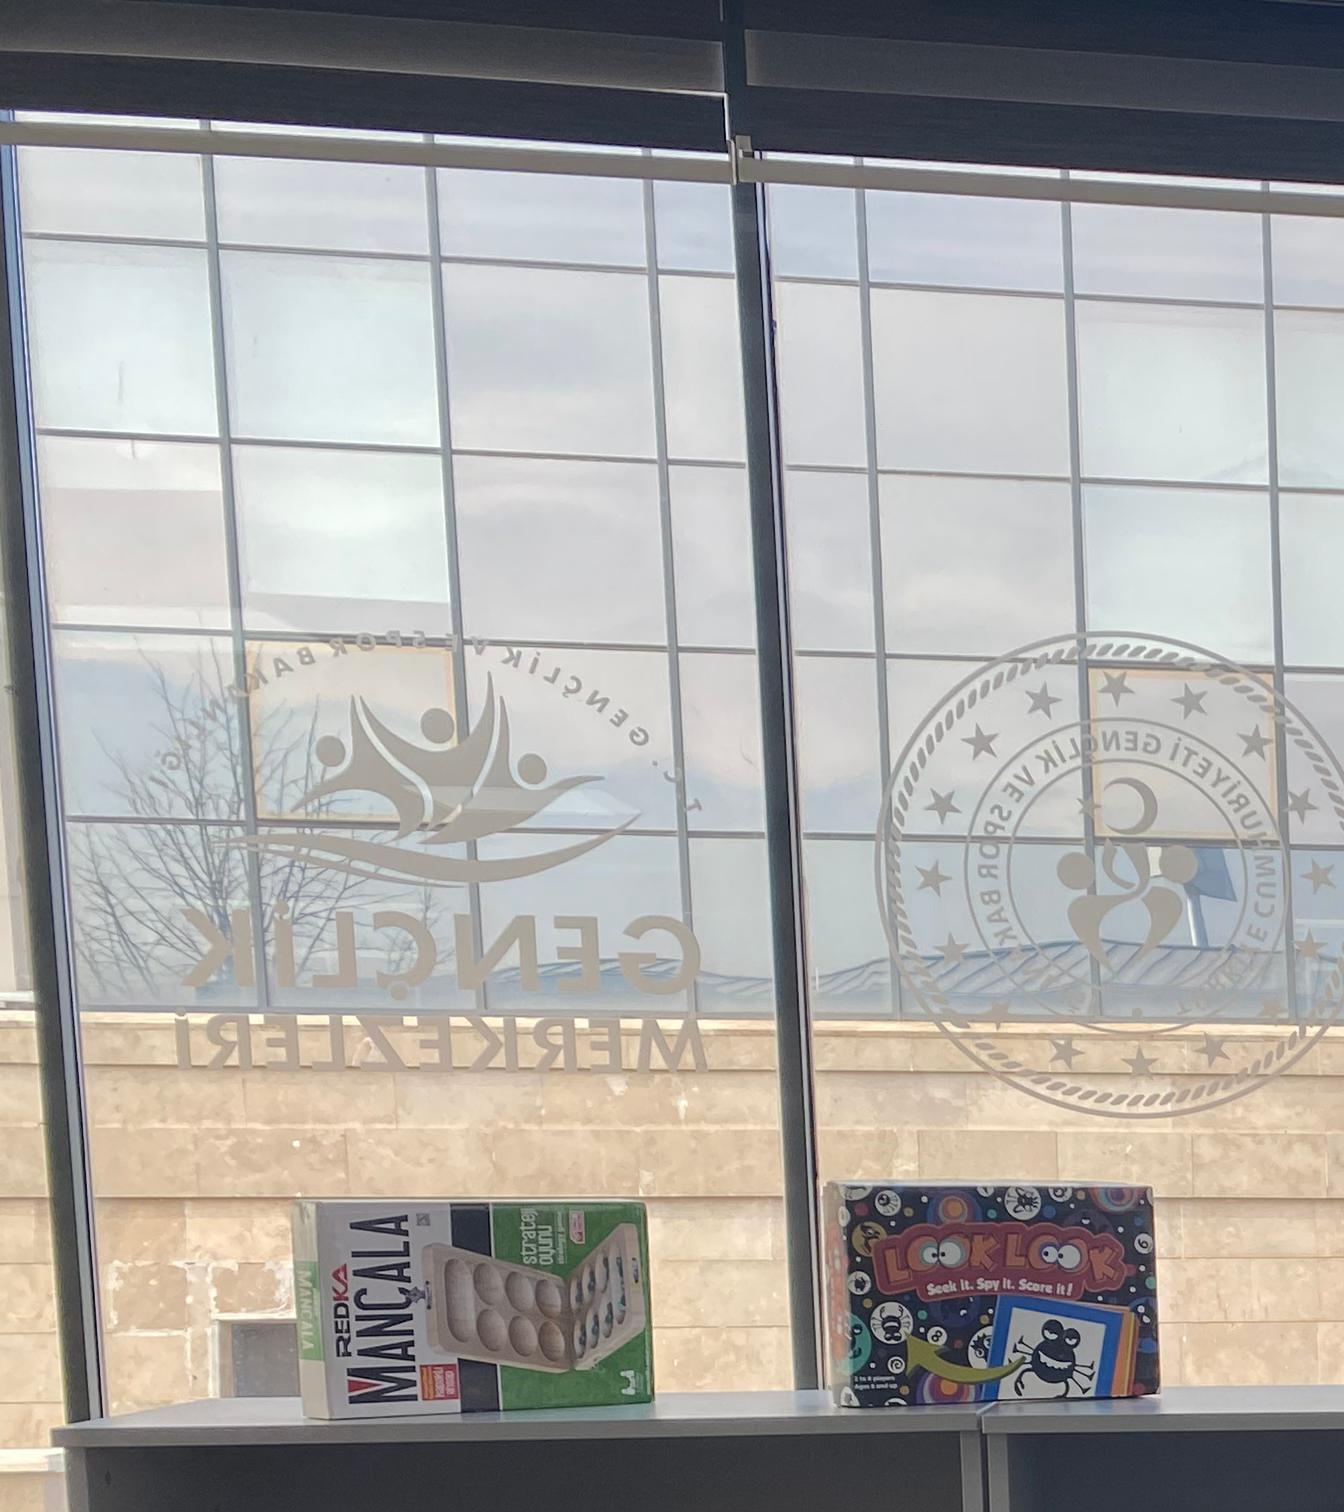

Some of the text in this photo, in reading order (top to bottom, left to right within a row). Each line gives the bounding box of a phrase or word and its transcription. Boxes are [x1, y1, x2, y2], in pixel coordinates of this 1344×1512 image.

[331, 1263, 352, 1358] REDKA
[347, 1214, 418, 1404] MANCALA
[927, 1280, 957, 1296] Seek
[976, 1277, 1000, 1291] Spy
[1018, 1279, 1053, 1293] Score
